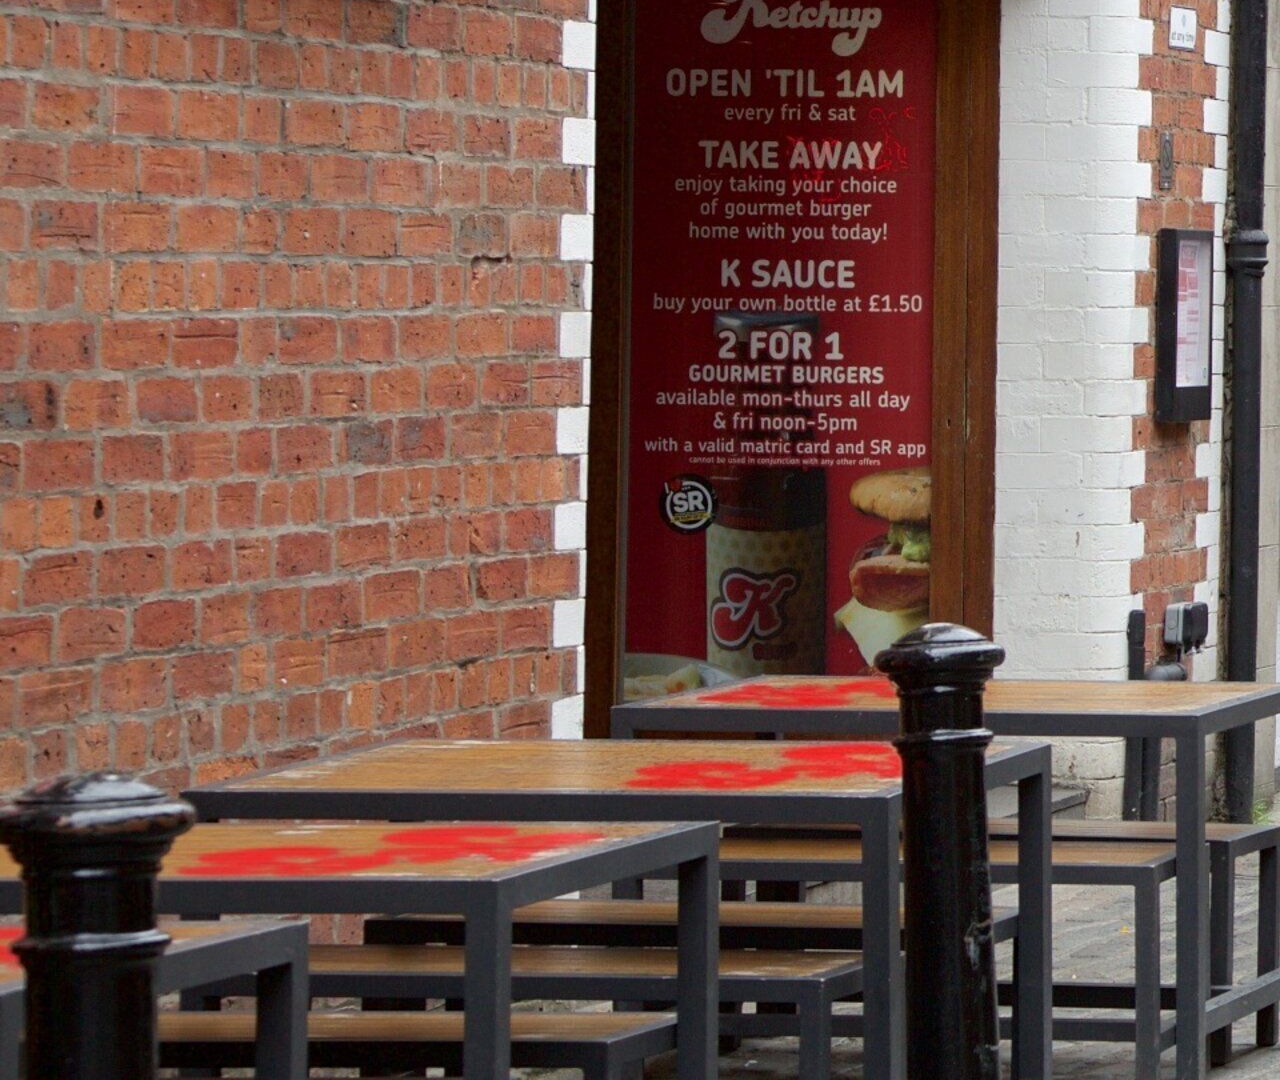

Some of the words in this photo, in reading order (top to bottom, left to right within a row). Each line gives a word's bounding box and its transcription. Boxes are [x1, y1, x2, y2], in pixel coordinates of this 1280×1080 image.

[666, 68, 751, 97] OPEN
[766, 68, 825, 98] 'TIL
[836, 69, 904, 98] 1AM
[724, 108, 774, 124] every
[781, 103, 801, 122] fri
[808, 104, 821, 121] &
[828, 105, 856, 121] sat
[698, 140, 779, 169] TAKE
[789, 140, 883, 170] AWAY
[675, 177, 723, 195] enjoy
[730, 176, 786, 196] taking
[792, 178, 834, 196] your
[840, 176, 897, 194] choice
[700, 199, 719, 217] of
[725, 201, 802, 219] gourmet
[810, 200, 871, 220] burger
[689, 222, 739, 239] home
[746, 222, 784, 239] with
[792, 226, 824, 243] you
[832, 223, 888, 244] today!
[721, 259, 741, 288] K
[752, 259, 856, 289] SAUCE
[653, 293, 685, 313] buy
[692, 297, 732, 313] your
[739, 297, 776, 311] own
[783, 295, 836, 312] bottle
[843, 296, 861, 312] at
[868, 294, 923, 313] £1.50
[718, 331, 737, 360] 2
[750, 331, 812, 360] FOR
[825, 331, 844, 361] 1
[689, 365, 786, 383] GOURMET
[792, 366, 884, 384] BURGERS
[656, 390, 736, 407] available
[743, 390, 842, 408] mon-thurs
[849, 391, 871, 408] all
[878, 391, 911, 412] day
[713, 412, 726, 430] &
[733, 412, 753, 430] fri
[760, 413, 857, 434] noon-5pm
[645, 437, 678, 453] with
[684, 441, 692, 452] a
[700, 437, 735, 453] valid
[740, 438, 790, 454] matric
[796, 439, 830, 455] card
[836, 440, 864, 456] and
[870, 440, 892, 456] SR
[898, 443, 926, 457] app
[689, 456, 715, 465] cannot
[716, 456, 726, 464] be
[728, 456, 746, 465] used
[749, 457, 756, 465] in
[757, 456, 800, 467] conjunction
[802, 457, 819, 466] with
[820, 458, 834, 467] any
[836, 457, 856, 466] other
[858, 457, 881, 466] offers
[672, 490, 705, 513] SR
[711, 571, 797, 647] K
